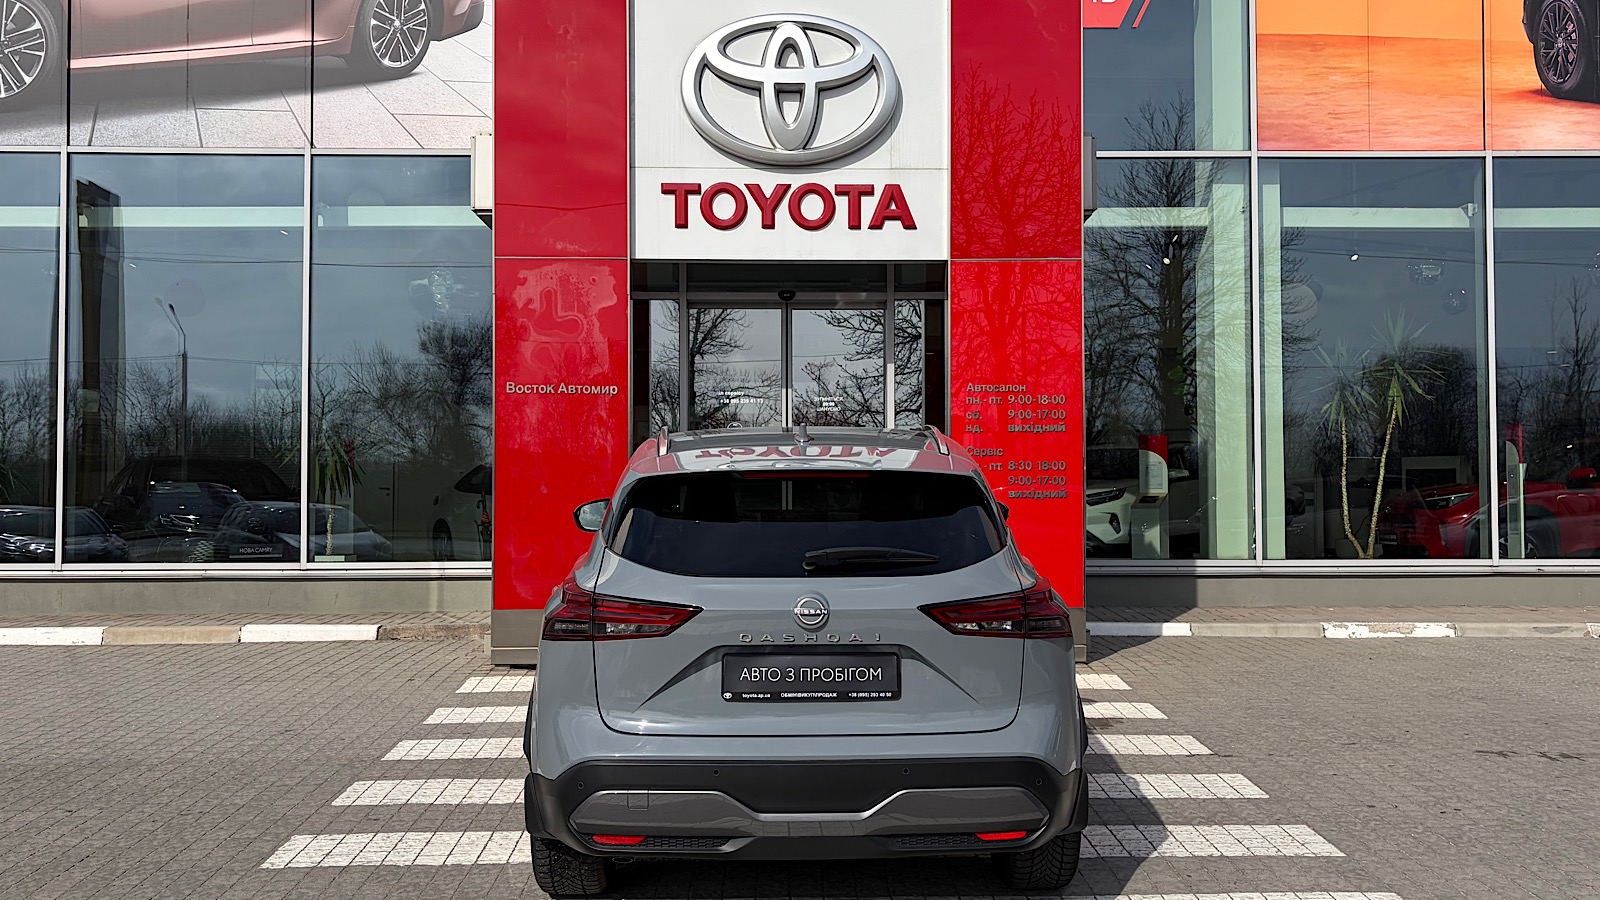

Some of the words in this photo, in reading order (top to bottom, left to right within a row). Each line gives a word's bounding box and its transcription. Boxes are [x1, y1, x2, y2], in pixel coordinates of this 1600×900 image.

[661, 182, 917, 230] TOYOTA
[506, 382, 555, 394] Восток
[557, 382, 618, 397] Автомир
[966, 382, 1026, 392] Автосалон
[1007, 395, 1066, 405] 9:00-18:00
[966, 410, 983, 420] сб.
[1007, 409, 1066, 420] 9:00-17:00
[1008, 422, 1066, 434] вихідний
[966, 446, 1004, 458] Сервіс
[1008, 475, 1067, 486] 9:00-17:00
[1008, 488, 1067, 500] вихідний
[794, 607, 828, 615] NISSAN
[739, 633, 881, 643] QASHQAI
[739, 667, 782, 682] АВТО
[799, 667, 882, 682] ПРОБІГОМ
